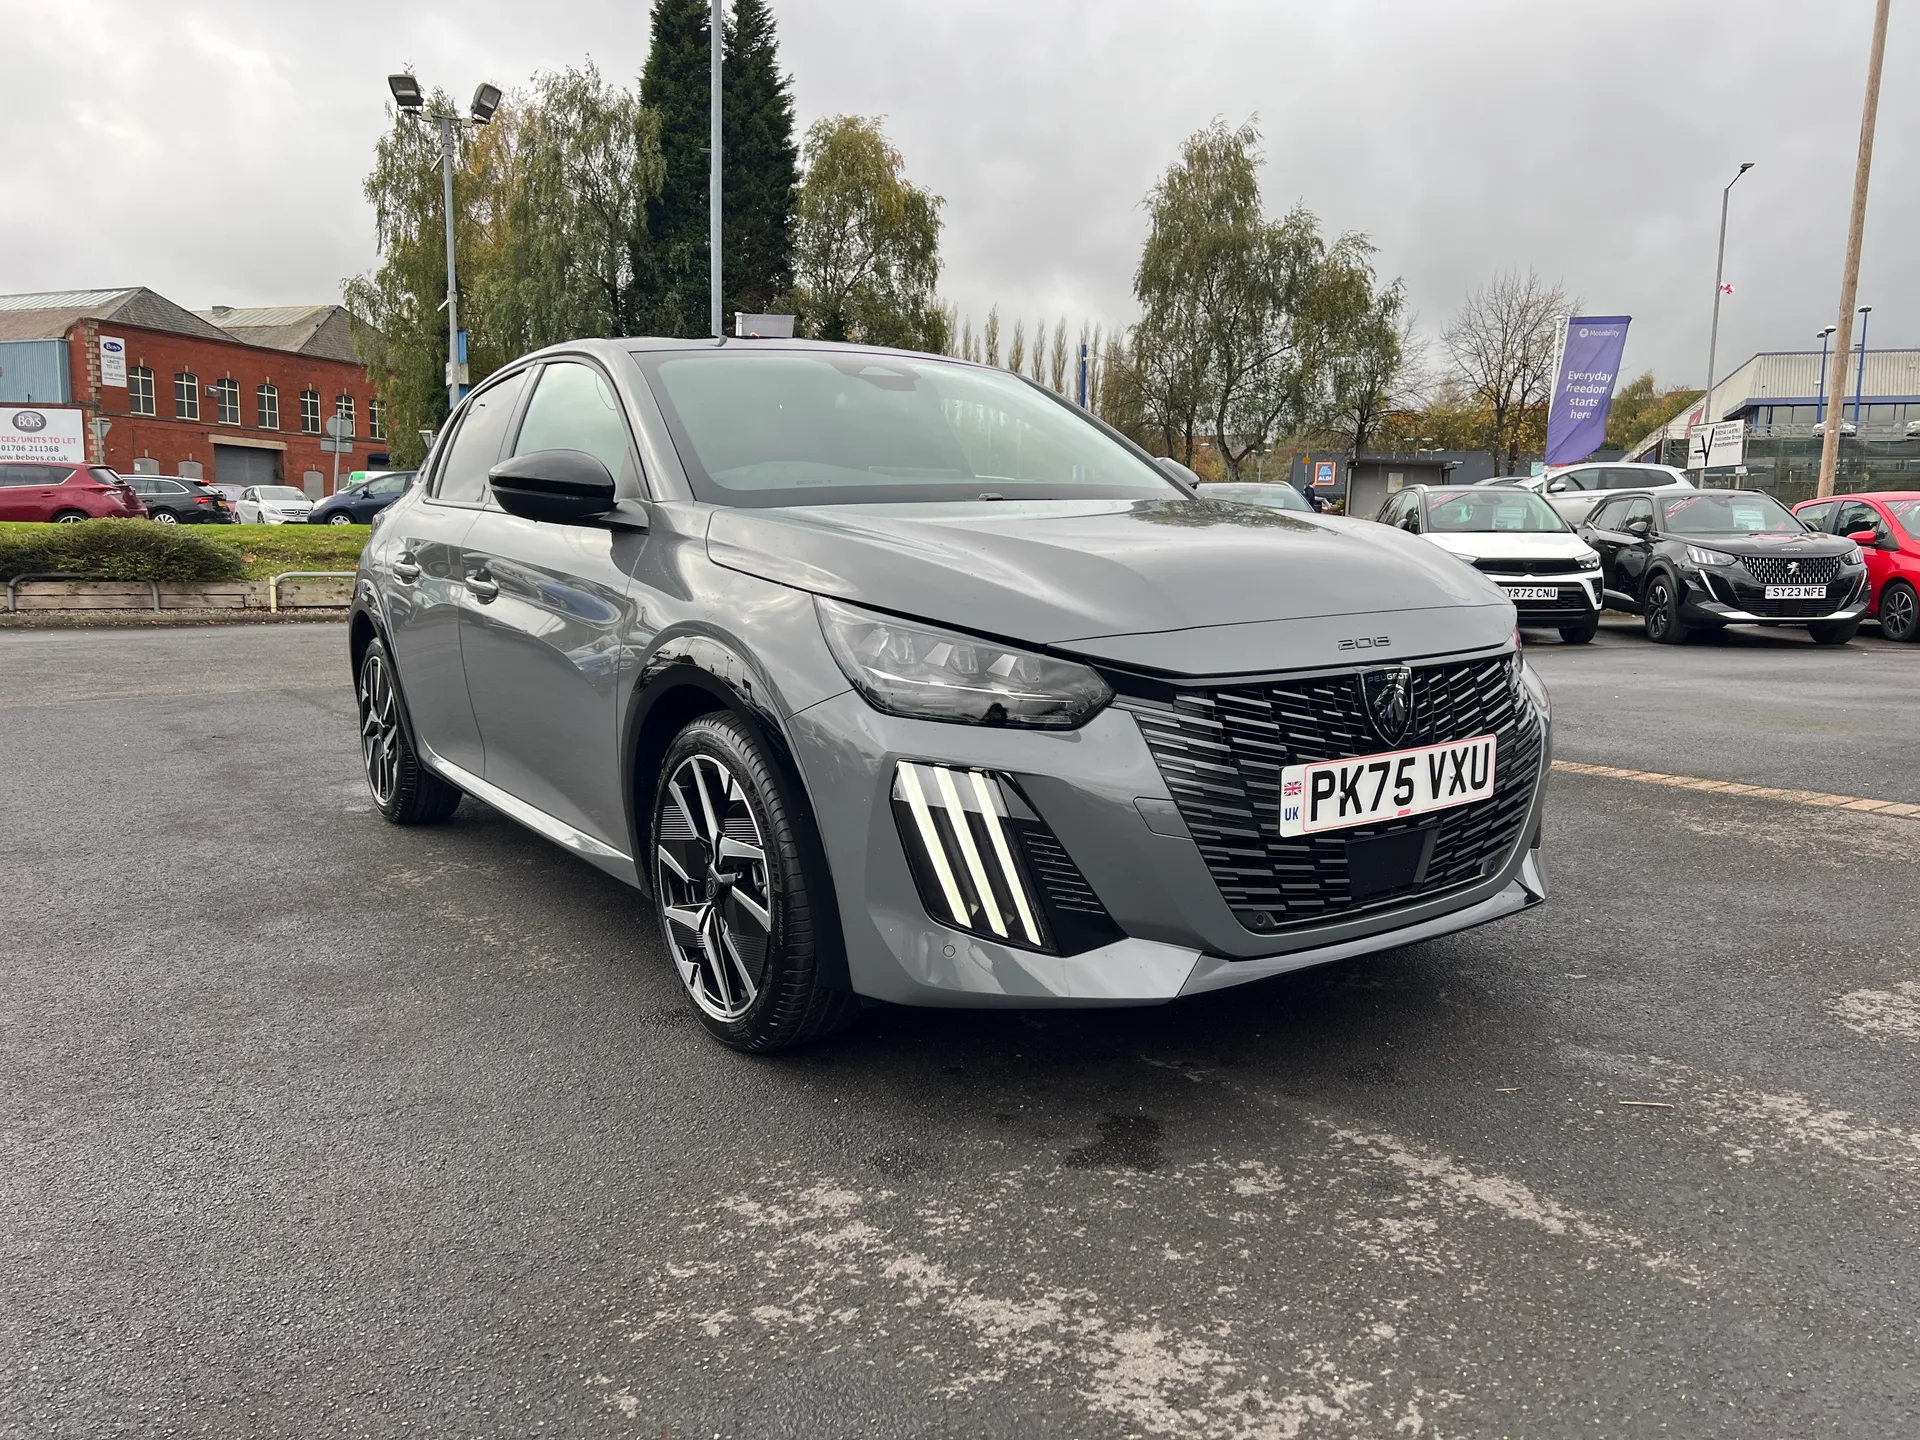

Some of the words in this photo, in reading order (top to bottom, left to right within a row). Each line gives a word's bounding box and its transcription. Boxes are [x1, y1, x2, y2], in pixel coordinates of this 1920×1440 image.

[1590, 330, 1620, 338] Motability
[1567, 370, 1613, 383] Everyday
[1566, 383, 1607, 394] freedom
[1569, 397, 1599, 407] starts
[1570, 409, 1592, 419] here
[1507, 588, 1534, 598] YR72
[1536, 588, 1556, 598] CNU
[1773, 587, 1801, 597] SY23
[1804, 587, 1825, 597] NFE
[1367, 672, 1409, 683] PEUGEOT
[1310, 757, 1416, 822] PK75
[1429, 743, 1490, 800] VXU
[1284, 806, 1299, 821] UK
